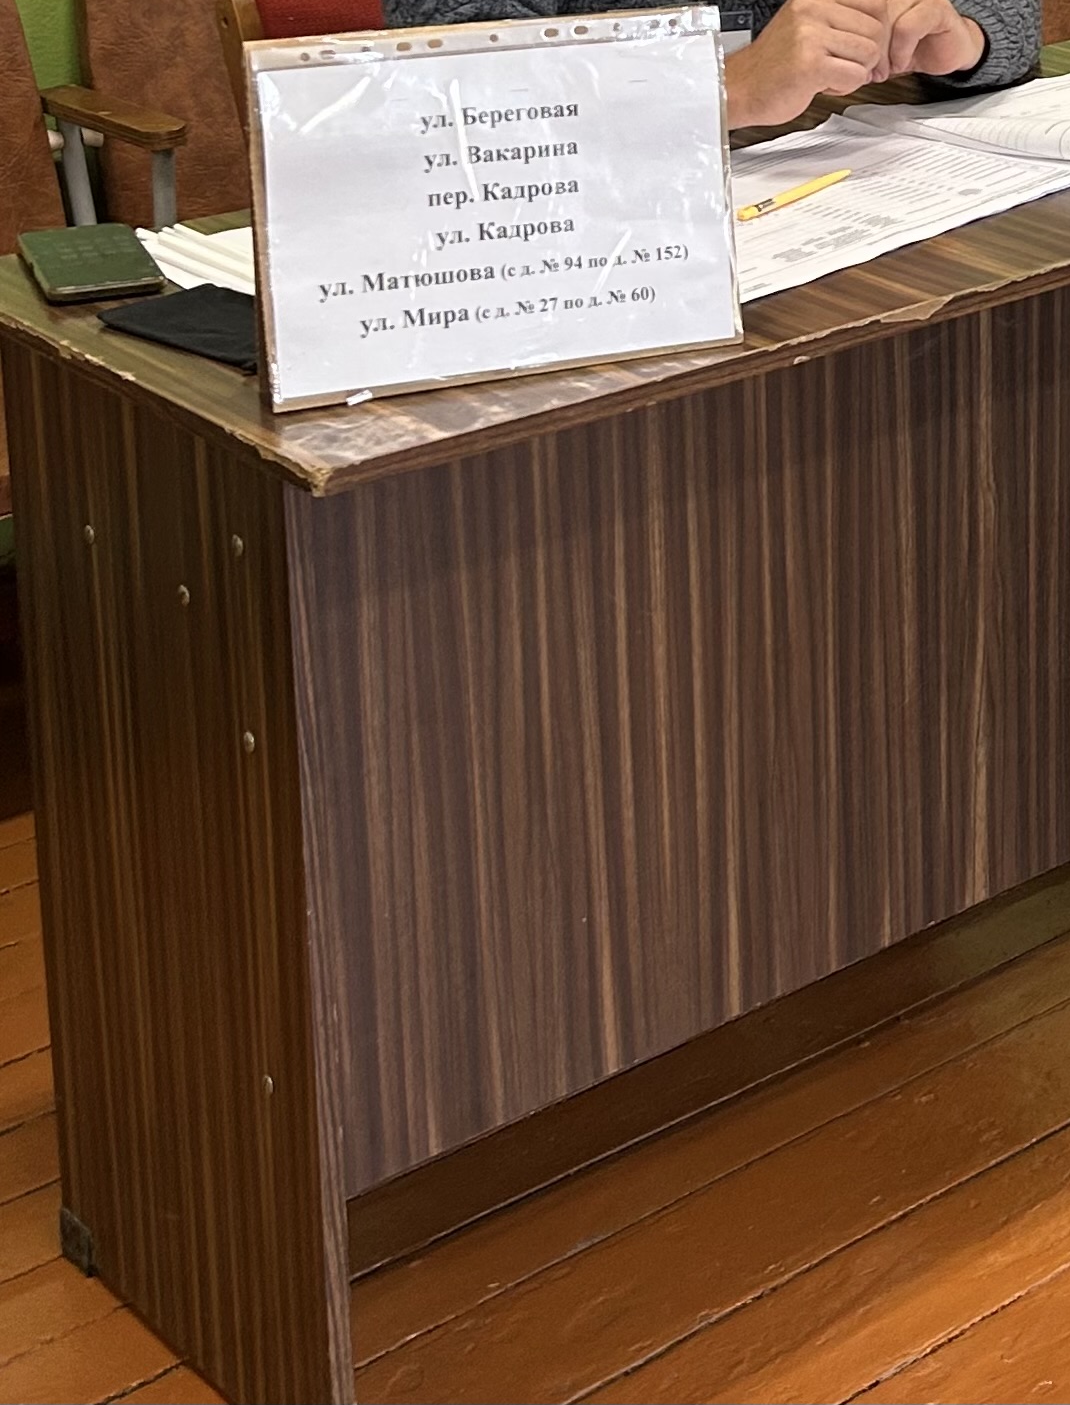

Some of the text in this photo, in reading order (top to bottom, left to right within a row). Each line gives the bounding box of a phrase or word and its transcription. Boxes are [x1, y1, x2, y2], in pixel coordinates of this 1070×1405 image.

[420, 103, 579, 135] ул. Береговая
[423, 141, 579, 174] ул. Вакарина
[427, 179, 579, 210] пер. Кадрова
[435, 218, 575, 251] ул. Кадрова
[318, 243, 689, 304] ул. Матюшова (с д. № 94 по д. № 152)
[359, 285, 656, 339] ул. Мира (с д. № 27 по д. № 60)
